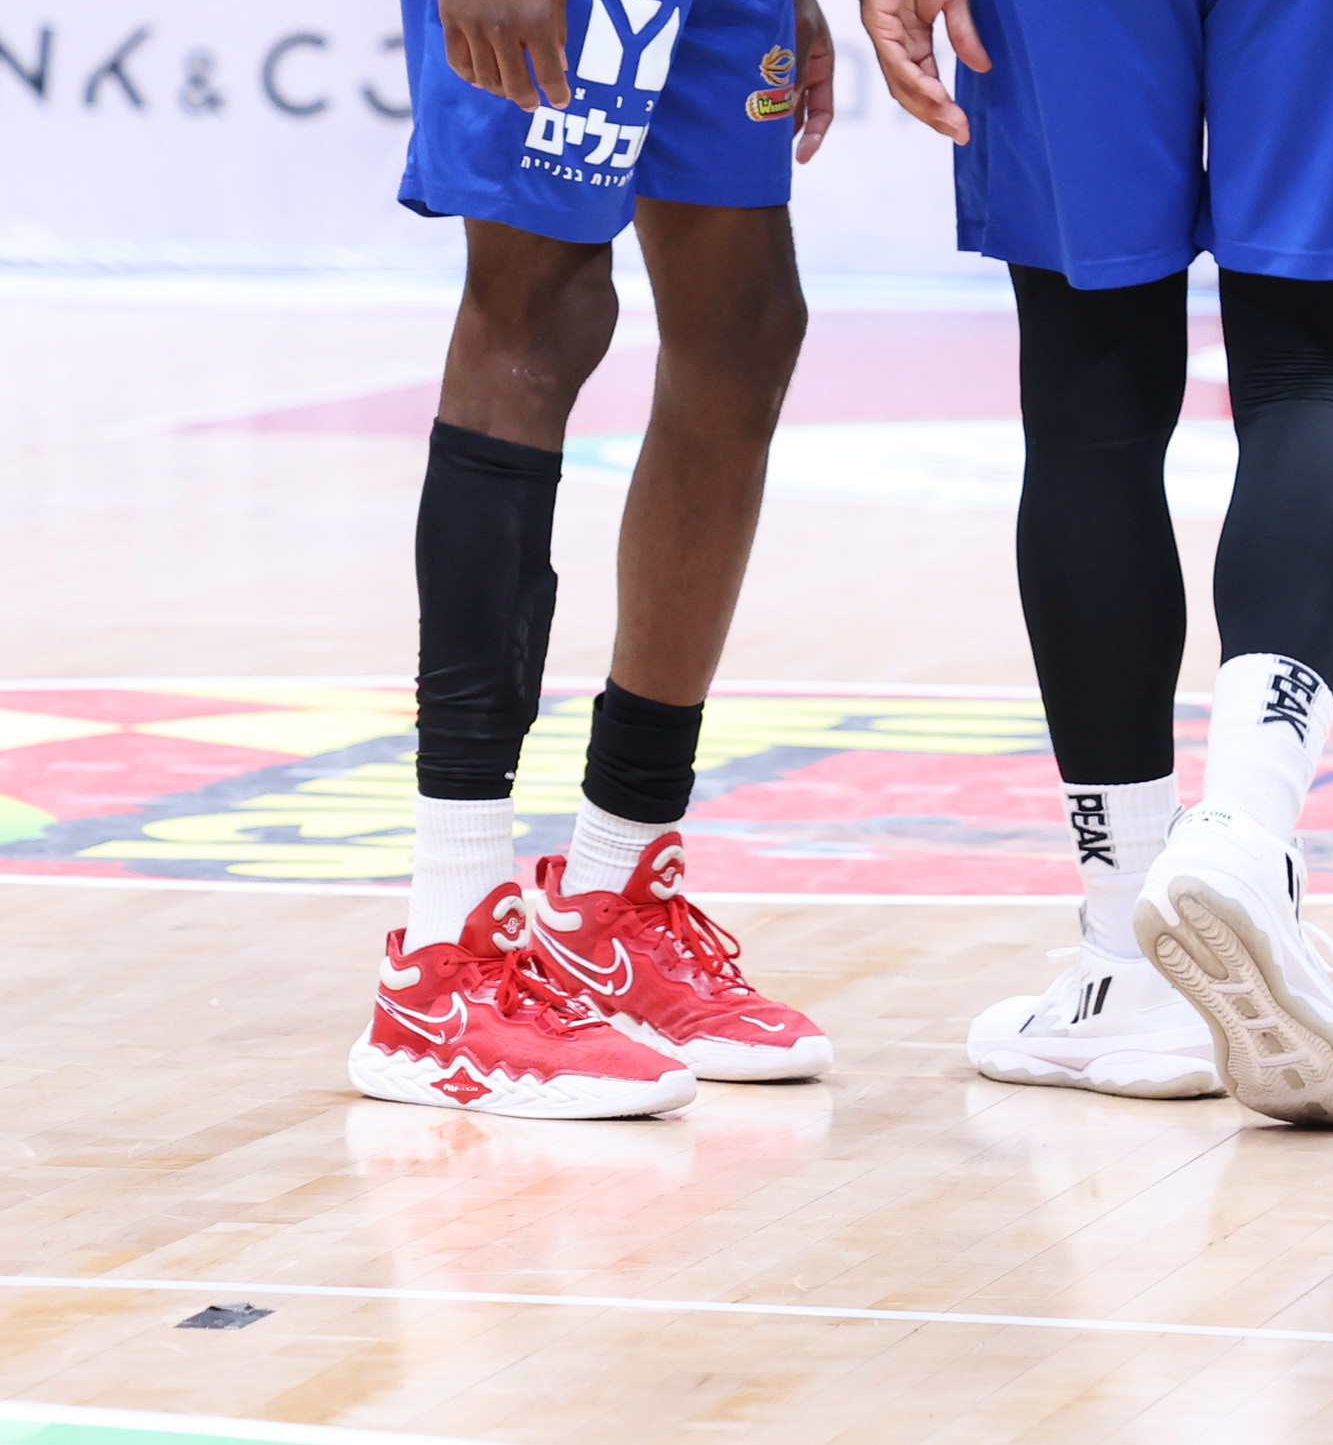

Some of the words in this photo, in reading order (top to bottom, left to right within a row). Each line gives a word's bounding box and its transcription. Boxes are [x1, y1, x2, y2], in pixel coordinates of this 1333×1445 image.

[179, 50, 226, 115] &
[1258, 655, 1324, 747] PEAK
[1067, 791, 1120, 870] PEAK
